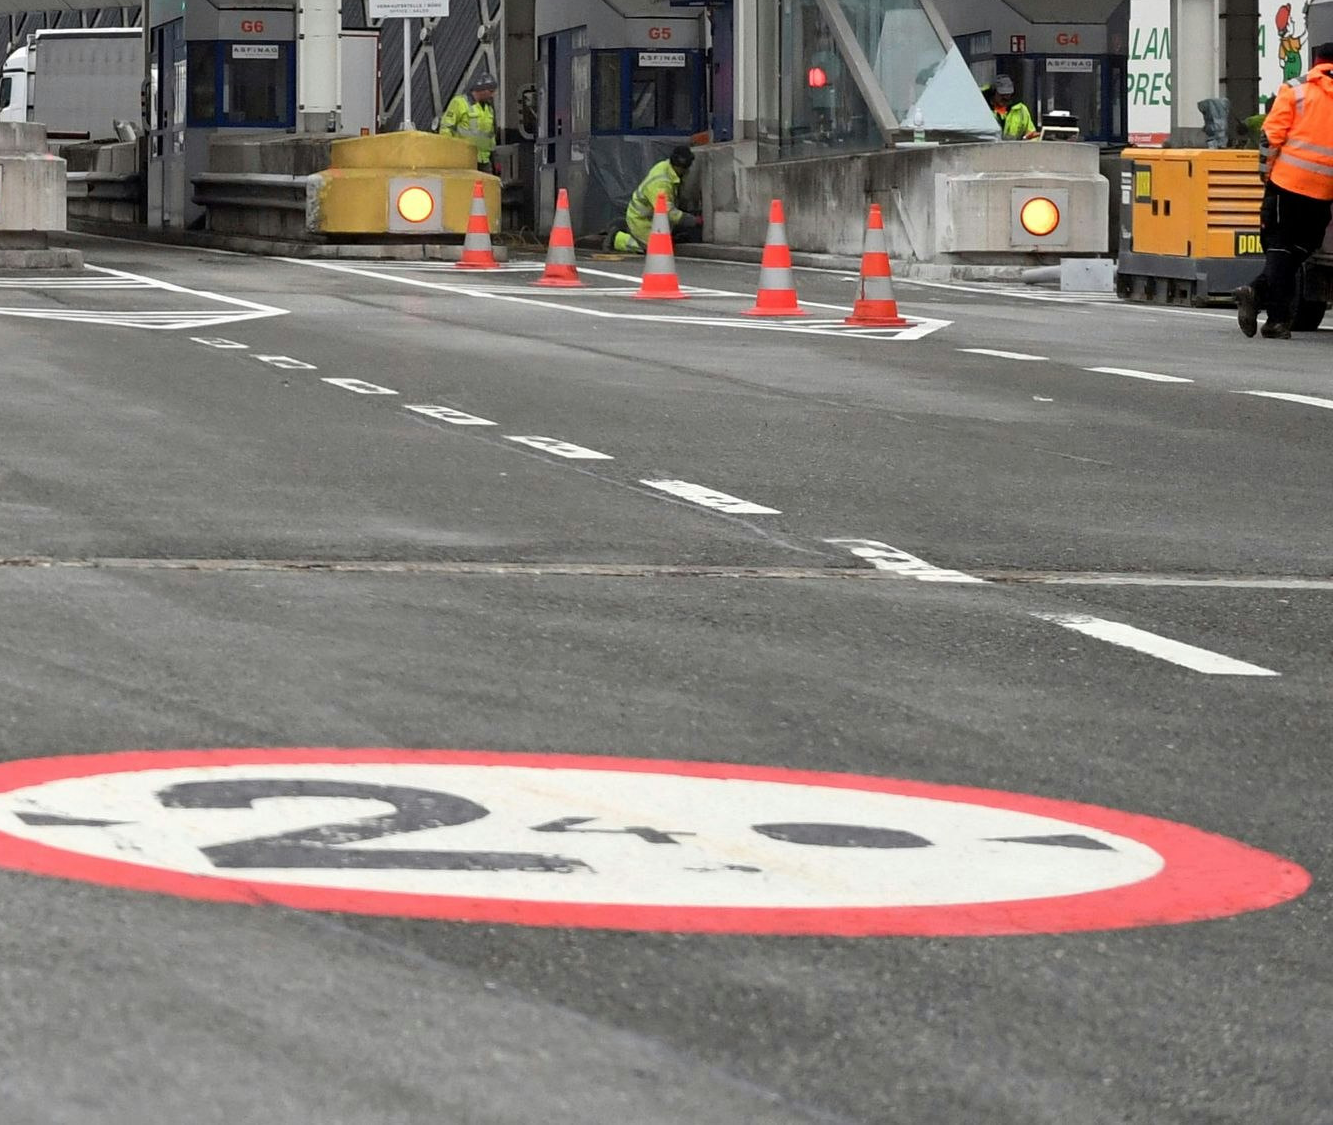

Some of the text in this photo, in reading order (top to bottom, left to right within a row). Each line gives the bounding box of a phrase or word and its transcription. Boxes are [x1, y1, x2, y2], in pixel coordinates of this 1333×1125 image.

[241, 20, 264, 33] G6
[648, 27, 672, 40] G5
[1056, 33, 1080, 46] G4
[1128, 27, 1171, 60] LAN
